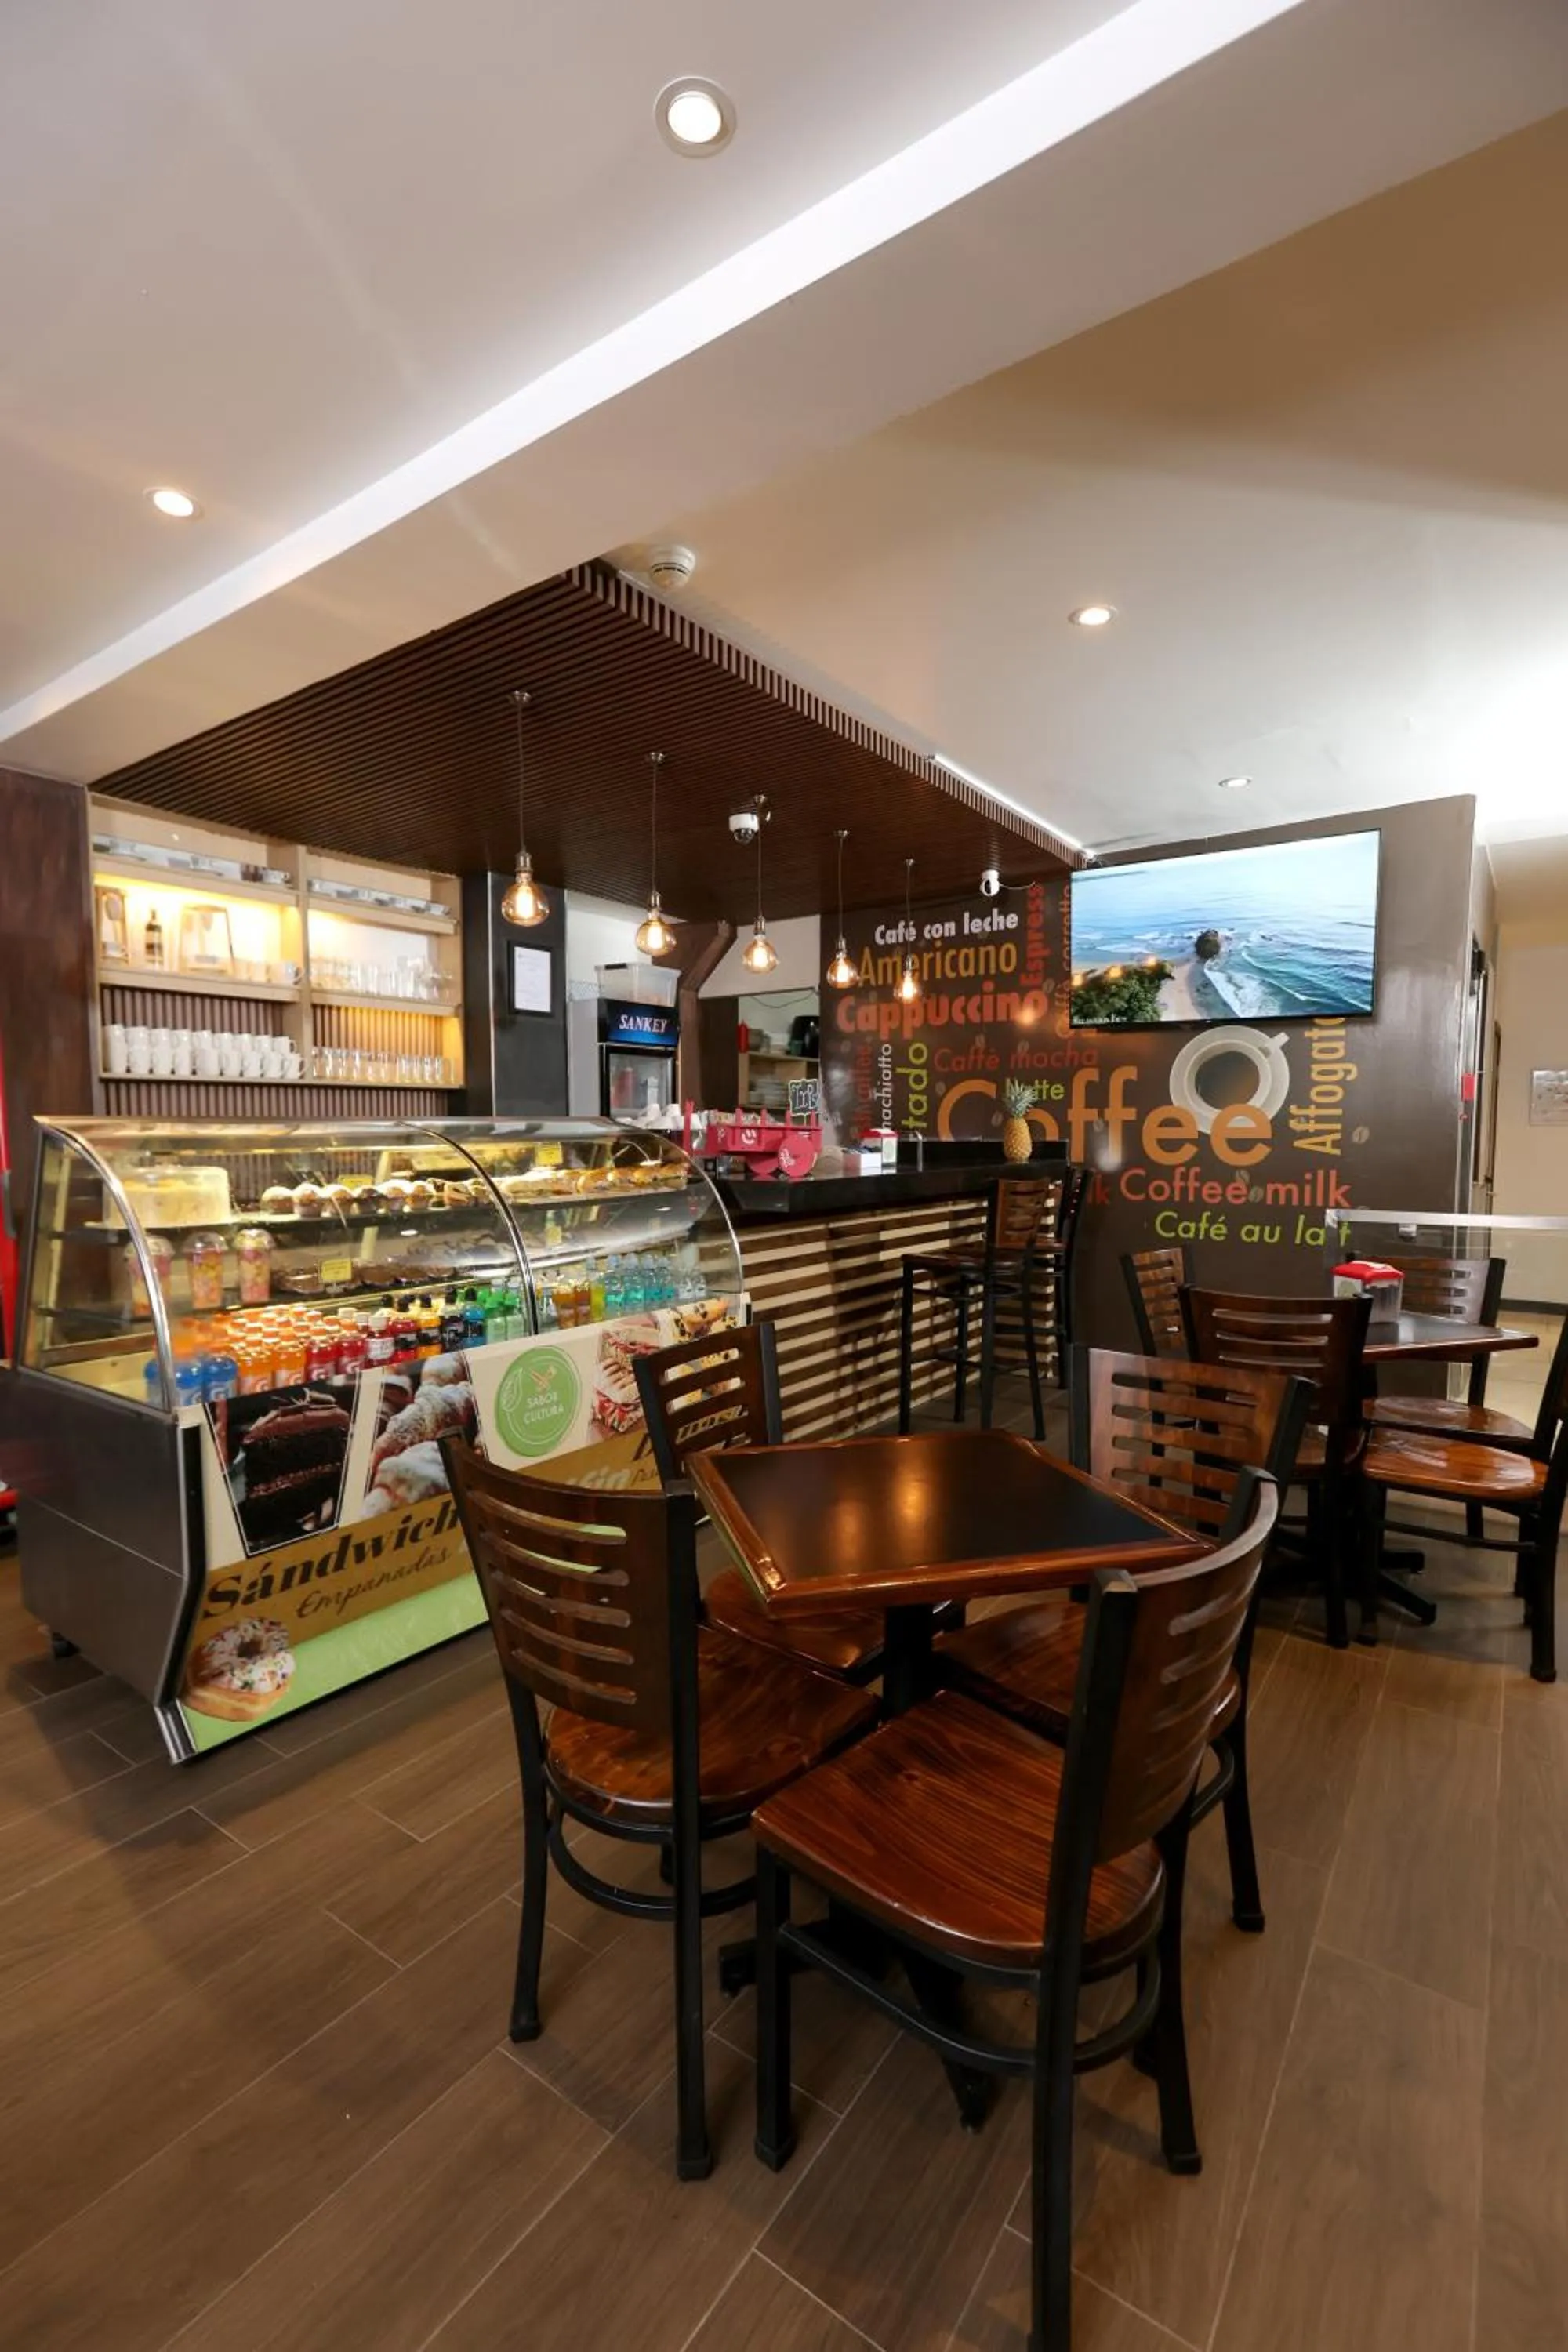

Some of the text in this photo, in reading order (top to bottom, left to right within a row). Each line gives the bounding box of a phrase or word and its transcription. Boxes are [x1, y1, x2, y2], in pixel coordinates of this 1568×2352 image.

[874, 908, 1018, 945] Café con leche
[858, 942, 1018, 987] Americano
[619, 1014, 667, 1033] SANKEY
[837, 982, 1048, 1040] Cappuccino
[1011, 1040, 1098, 1069] mocha
[895, 1043, 928, 1128] tado
[1006, 1076, 1065, 1100] Ltte
[1120, 1167, 1352, 1208] Coffee milk
[1155, 1211, 1352, 1247] Café au lat
[296, 1546, 452, 1619] Empanadas
